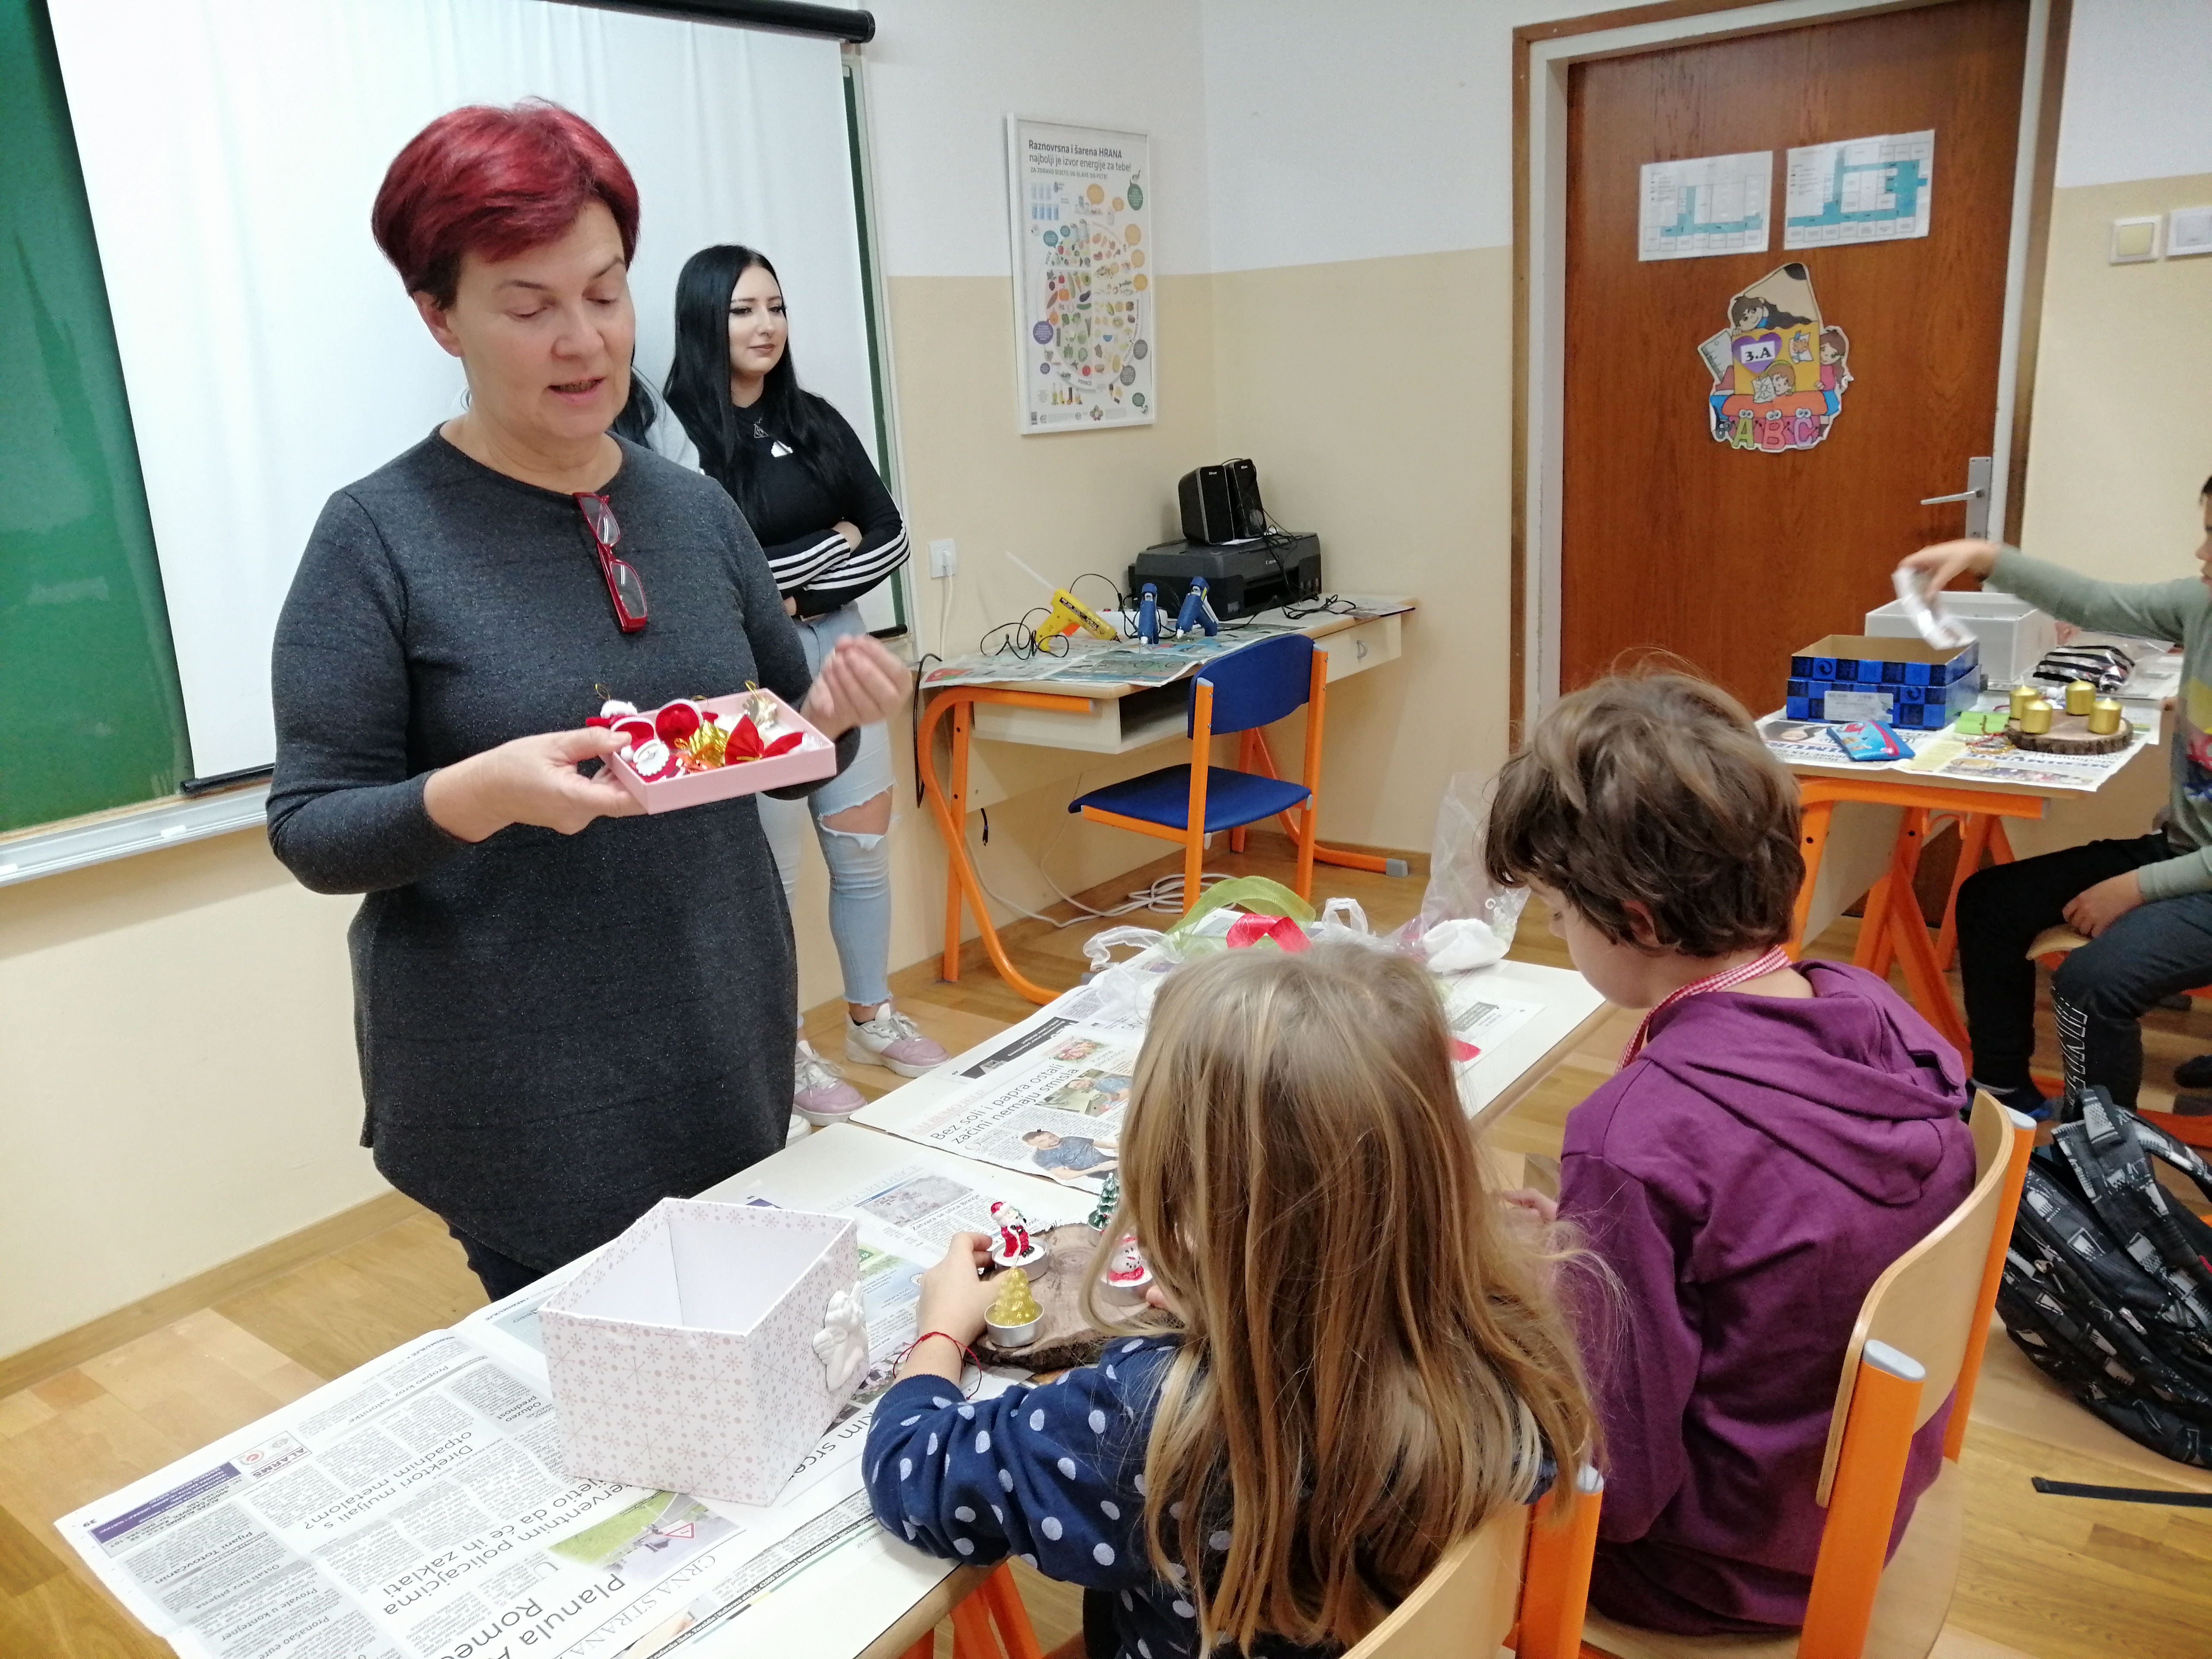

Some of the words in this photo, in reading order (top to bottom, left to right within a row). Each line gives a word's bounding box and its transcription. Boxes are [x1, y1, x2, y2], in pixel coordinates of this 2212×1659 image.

[1029, 140, 1069, 153] Raznovrsna
[1071, 143, 1073, 153] i
[1074, 144, 1097, 156] šarena
[1099, 148, 1122, 159] HRANA
[1030, 154, 1054, 166] najbolji
[1055, 156, 1061, 167] je
[1063, 156, 1078, 166] izvor
[1080, 159, 1106, 171] energije
[1116, 162, 1131, 172] tebe!
[1745, 347, 1772, 362] 3.A
[930, 1124, 961, 1141] Bez
[960, 1109, 986, 1128] soli
[985, 1105, 993, 1114] i
[992, 1084, 1031, 1107] papra
[1030, 1063, 1065, 1084] ostali
[950, 1121, 993, 1144] začini
[992, 1090, 1041, 1121] nemaju
[1039, 1068, 1080, 1097] smisla
[912, 1216, 937, 1231] Zatvara
[945, 1205, 961, 1214] ulica
[960, 1194, 981, 1206] Brezje
[485, 1300, 526, 1321] MEĐIMURJE
[416, 1366, 448, 1384] Propao
[394, 1385, 415, 1397] kroz
[496, 1395, 537, 1420] prednost
[506, 1402, 541, 1422] Oduzeo
[253, 1448, 307, 1477] ALARMS
[393, 1432, 471, 1477] otpadnim
[400, 1445, 473, 1488] Direktori
[788, 1442, 836, 1482] srce
[305, 1479, 389, 1529] metalom?
[338, 1488, 396, 1522] muljali
[519, 1510, 547, 1523] da
[83, 1519, 96, 1527] 39
[489, 1526, 515, 1541] će
[221, 1532, 253, 1549] Pijani
[462, 1539, 488, 1551] ih
[155, 1550, 219, 1584] Totovčanin
[251, 1565, 279, 1580] Ostali
[383, 1551, 458, 1597] zaklati
[383, 1540, 513, 1615] policajcima
[656, 1555, 715, 1595] CRNA
[232, 1580, 251, 1589] bez
[280, 1588, 318, 1608] Provale
[692, 1615, 715, 1636] Varaždin
[717, 1599, 742, 1618] Hallerova
[741, 1590, 755, 1605] aleja
[774, 1560, 796, 1580] Varaždin
[196, 1589, 230, 1609] plijena
[518, 1573, 626, 1646] Planula
[222, 1612, 270, 1641] kontejner
[283, 1616, 330, 1644] Pronašao
[440, 1598, 543, 1659] Rome
[570, 1594, 657, 1656] STRANA
